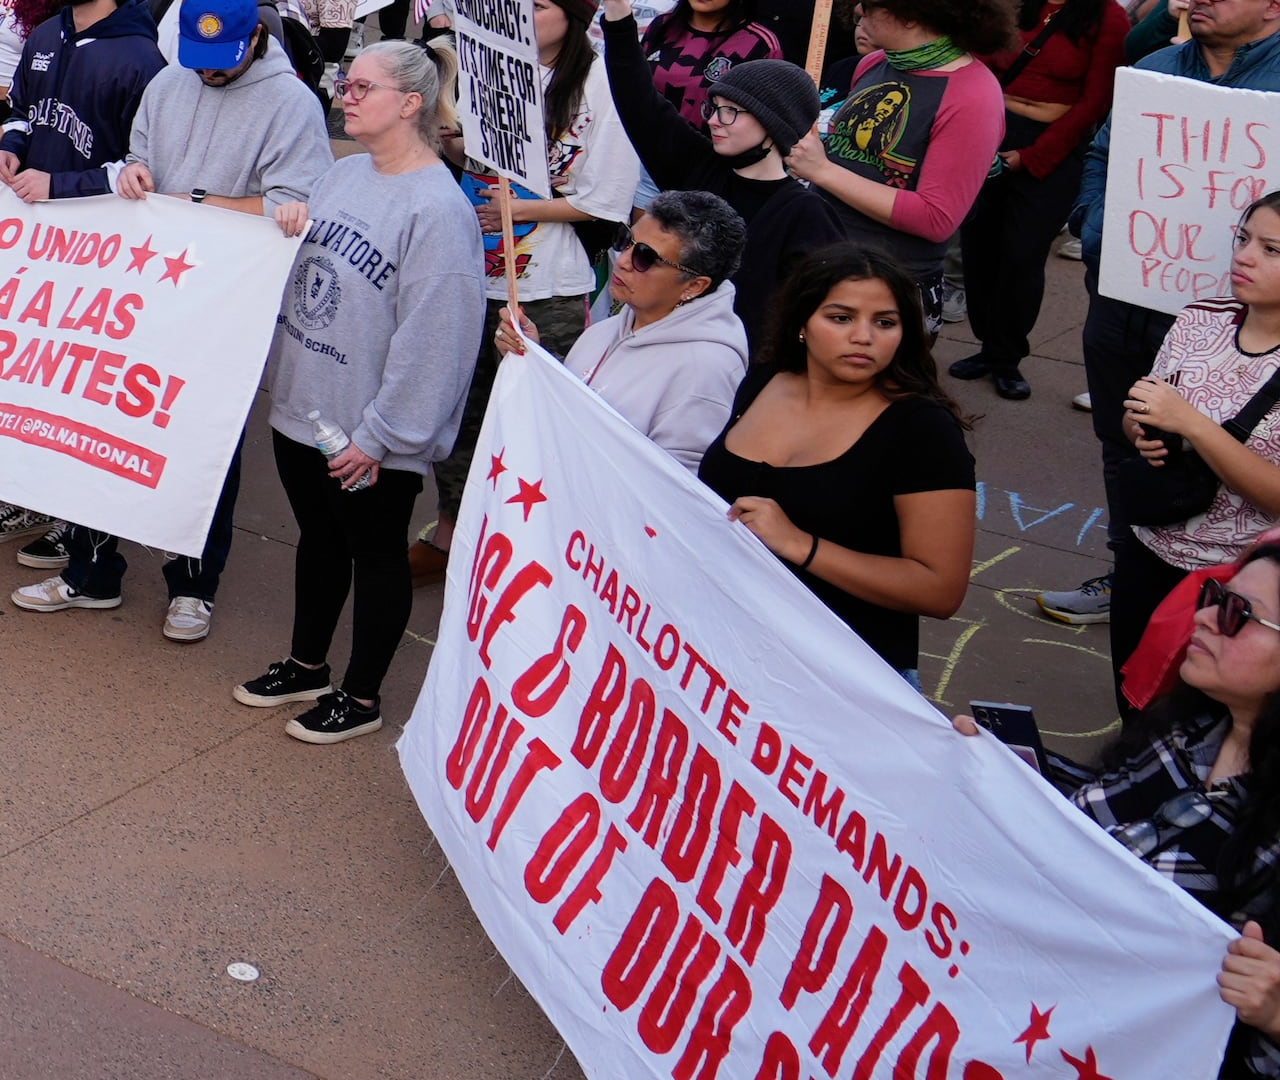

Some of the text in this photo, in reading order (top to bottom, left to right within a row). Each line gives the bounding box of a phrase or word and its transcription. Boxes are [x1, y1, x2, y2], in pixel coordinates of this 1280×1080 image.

[459, 30, 538, 107] IT'S TIME FOR
[470, 75, 532, 144] A GENERAL
[480, 117, 528, 180] STRIKE!
[827, 133, 886, 172] Marley
[1141, 112, 1270, 170] THIS
[1137, 157, 1267, 211] IS FOR
[27, 223, 122, 268] UNIDO
[1128, 209, 1217, 262] OUR
[17, 281, 55, 328] A
[57, 287, 144, 340] LAS
[20, 417, 154, 479] @PSLNATIONAL
[564, 528, 750, 747] CHARLOTTE
[750, 720, 972, 979] DEMANDS:
[569, 641, 794, 968] BORDER
[445, 675, 753, 1080] OUT OF OUR
